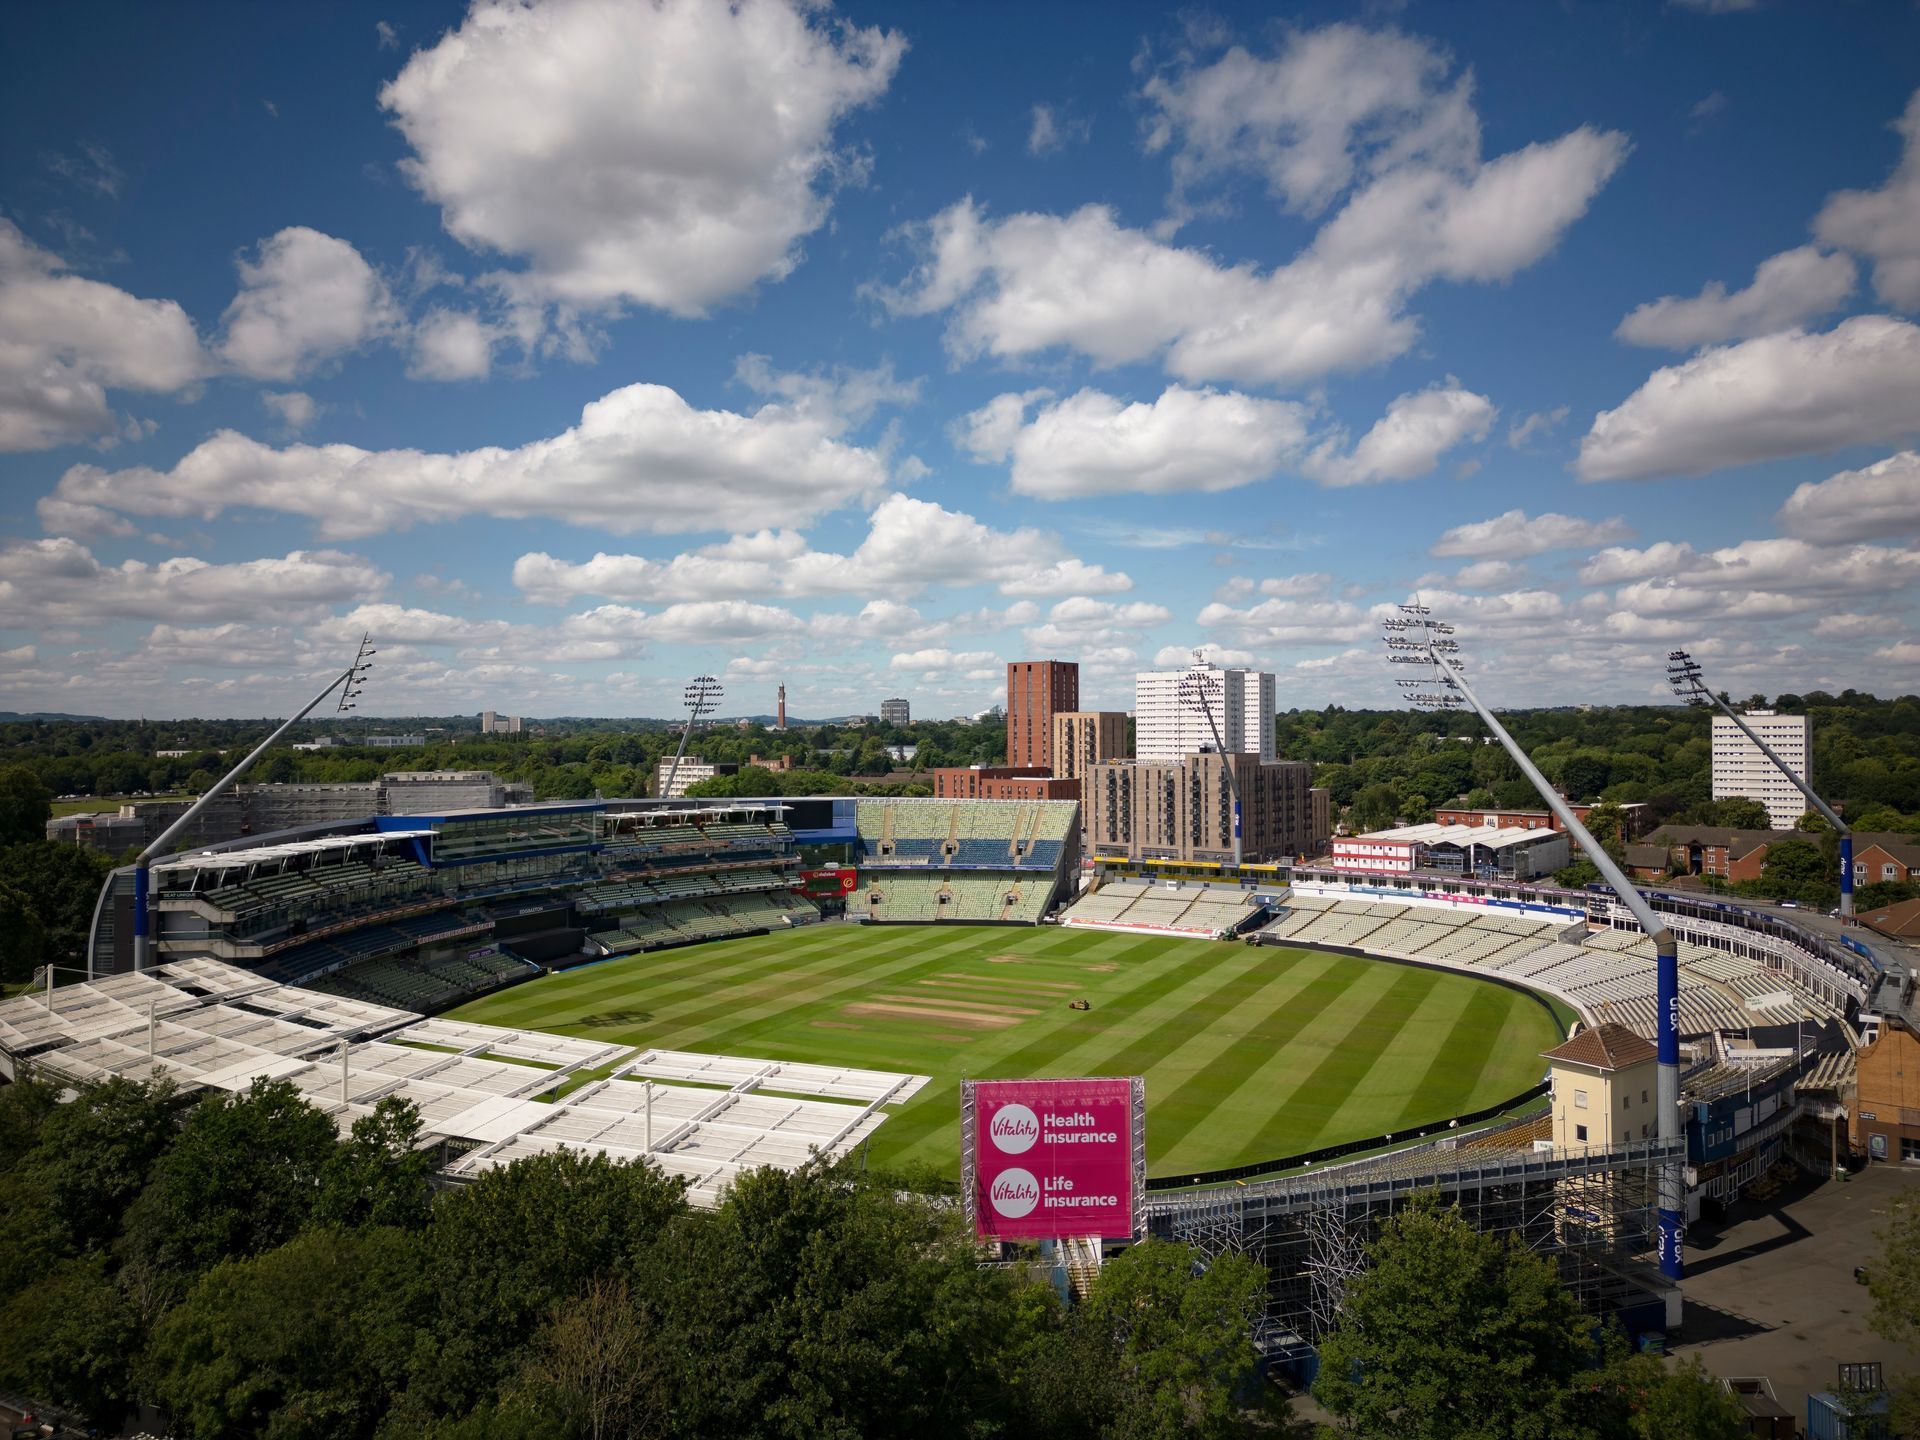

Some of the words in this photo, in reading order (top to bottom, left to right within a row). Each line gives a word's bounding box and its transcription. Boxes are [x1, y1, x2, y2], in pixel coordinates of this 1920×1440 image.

[519, 906, 544, 915] EDGBASTON
[1044, 1112, 1095, 1127] Health
[993, 1117, 1038, 1141] Vitality
[1044, 1129, 1117, 1144] insurance
[1044, 1175, 1074, 1191] Life
[993, 1180, 1038, 1205] Vitality
[1044, 1193, 1118, 1207] insurance
